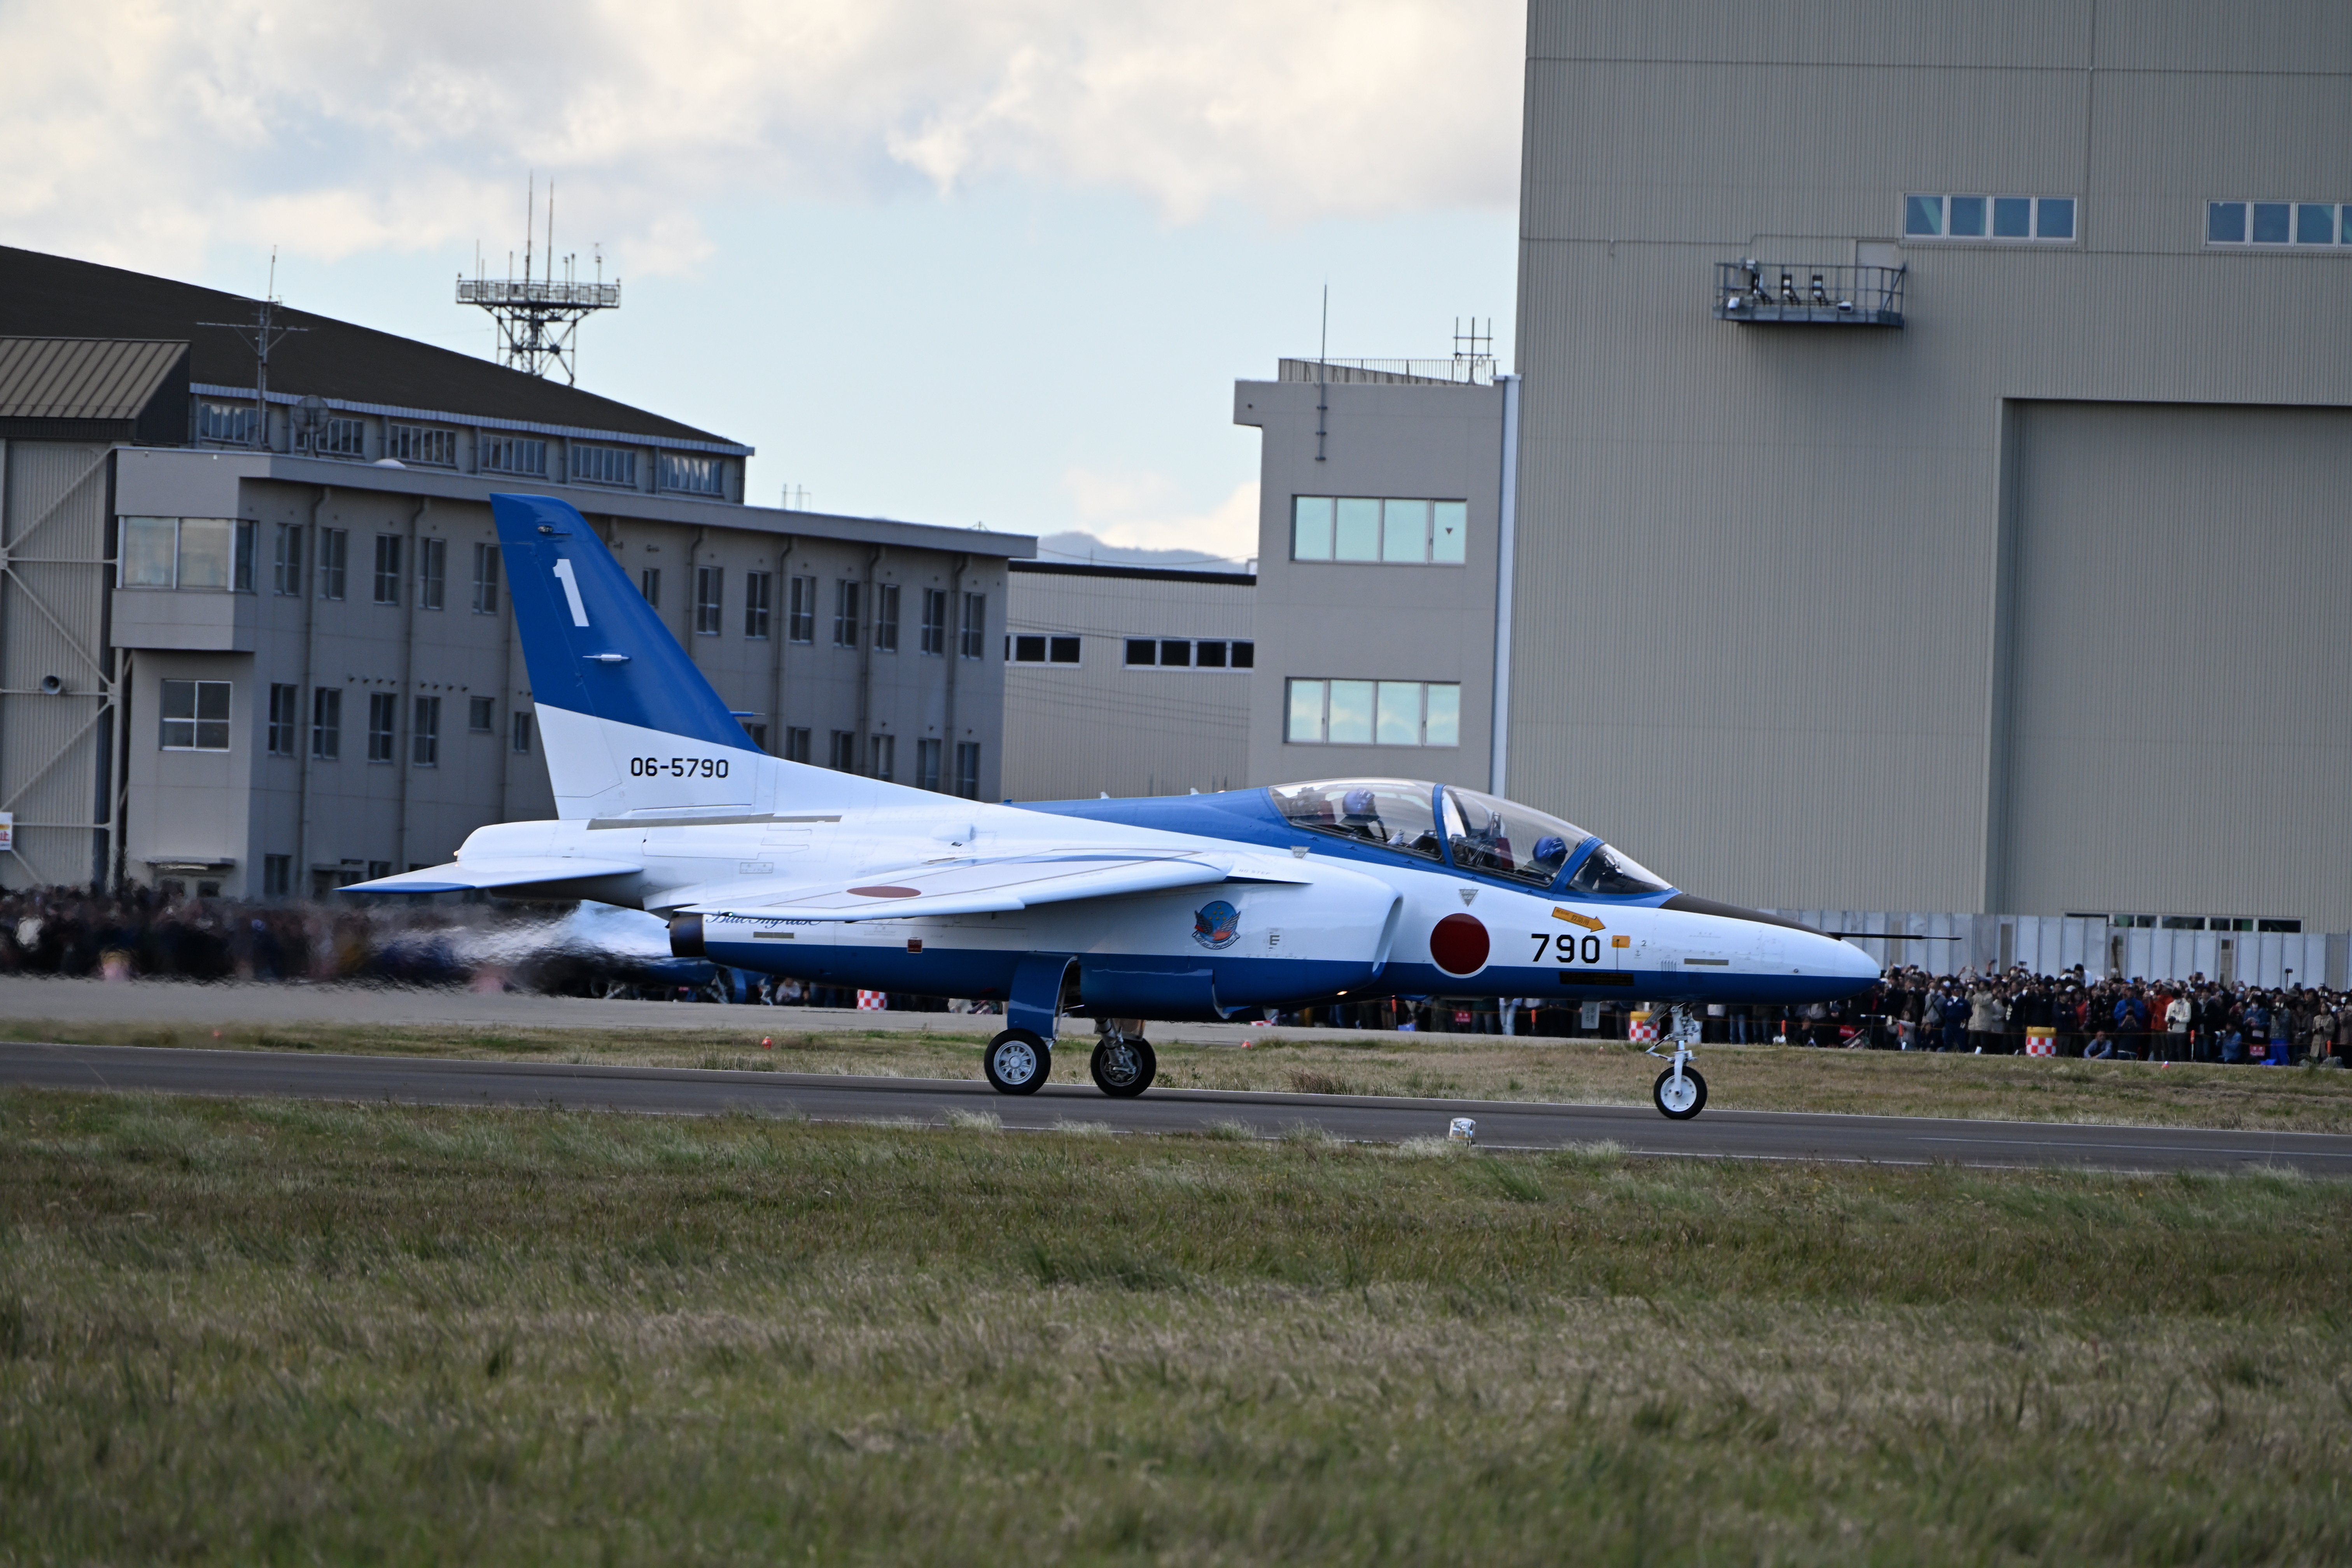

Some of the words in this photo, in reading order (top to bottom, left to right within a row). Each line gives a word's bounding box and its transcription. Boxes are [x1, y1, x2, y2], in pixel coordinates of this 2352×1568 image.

[553, 558, 589, 627] 1
[631, 757, 728, 778] 06-5790
[1531, 933, 1600, 964] 790
